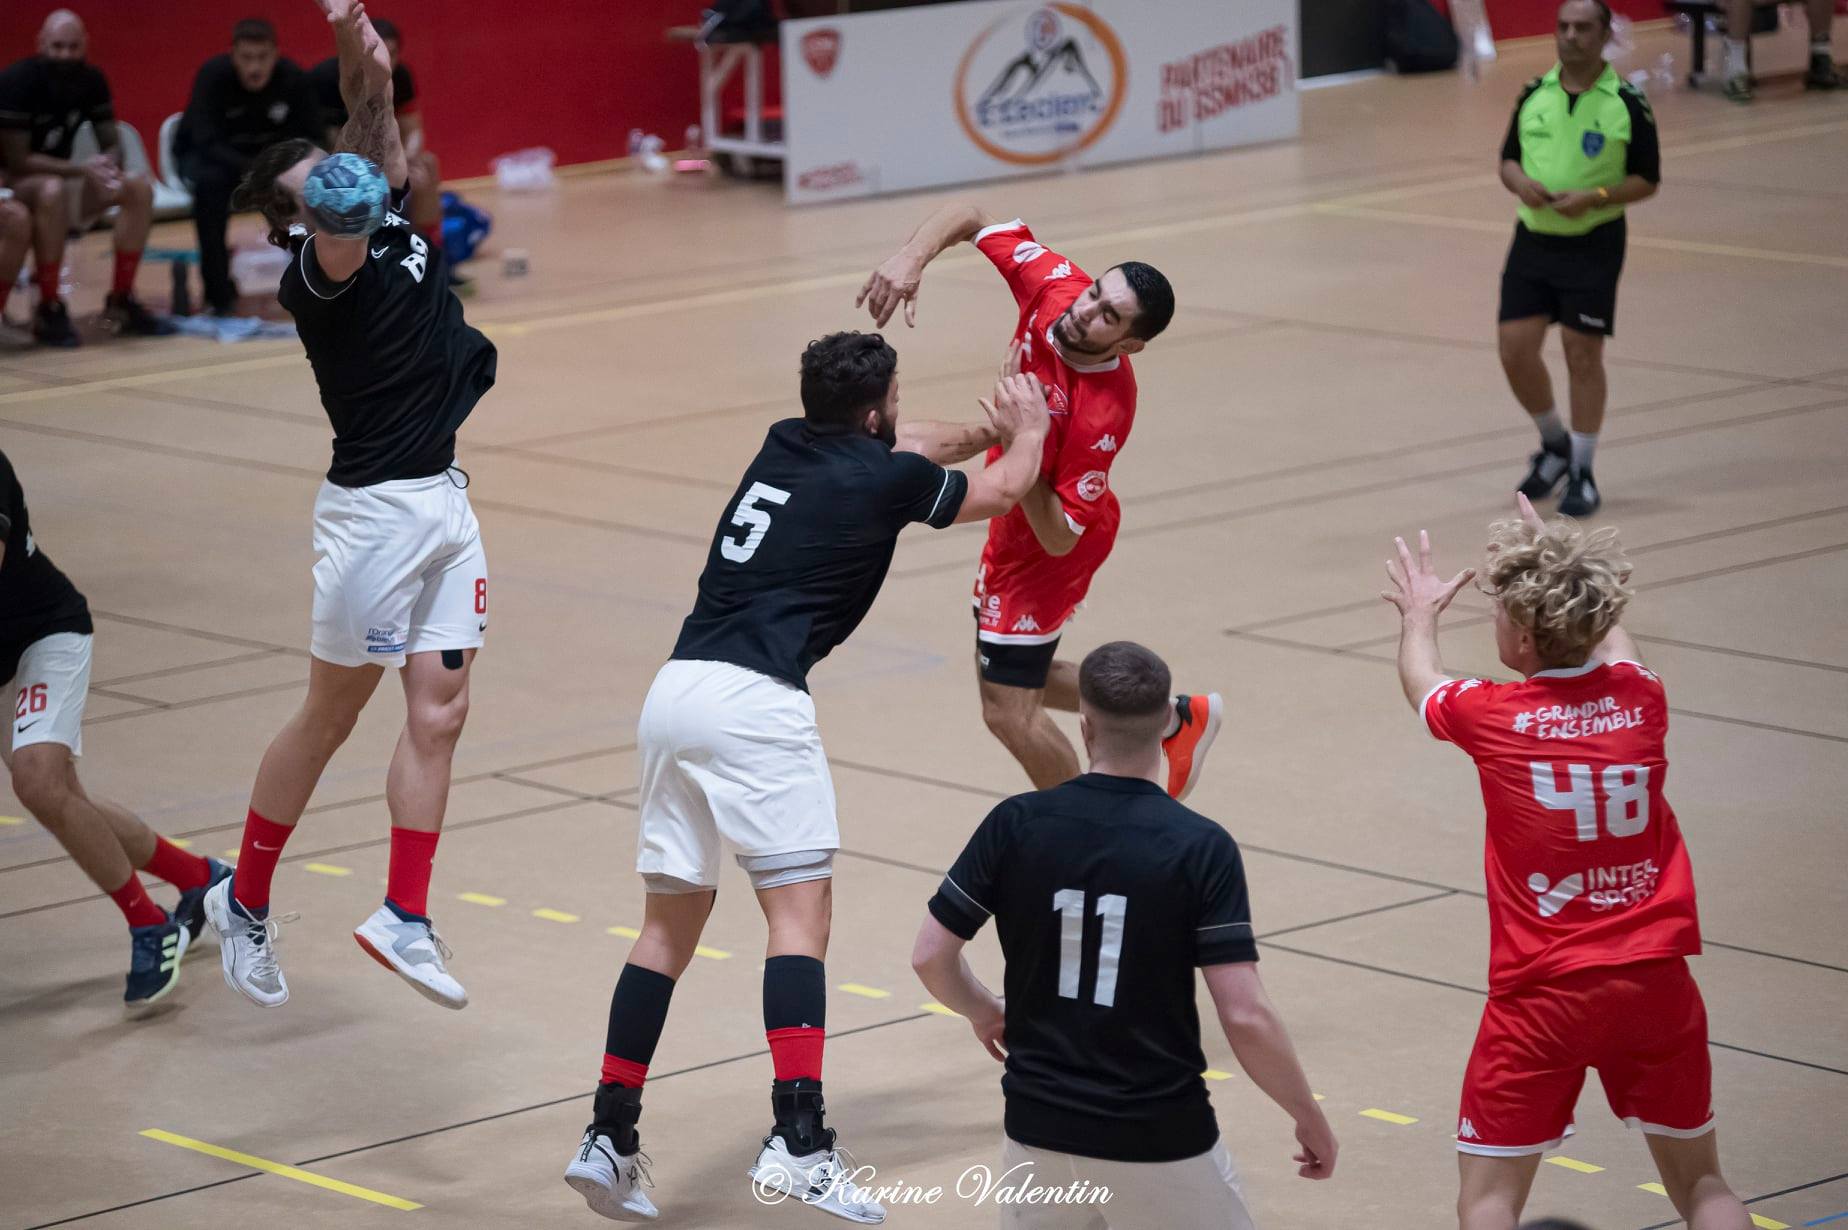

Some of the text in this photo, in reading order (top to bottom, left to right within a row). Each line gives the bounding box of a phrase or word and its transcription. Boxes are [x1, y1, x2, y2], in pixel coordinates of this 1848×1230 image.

[720, 480, 792, 564] 5
[16, 683, 48, 720] 26
[1512, 696, 1621, 733] #GRANDIR
[1538, 706, 1645, 740] ENSEMBLE
[1530, 761, 1651, 842] 48
[1053, 888, 1128, 1008] 11
